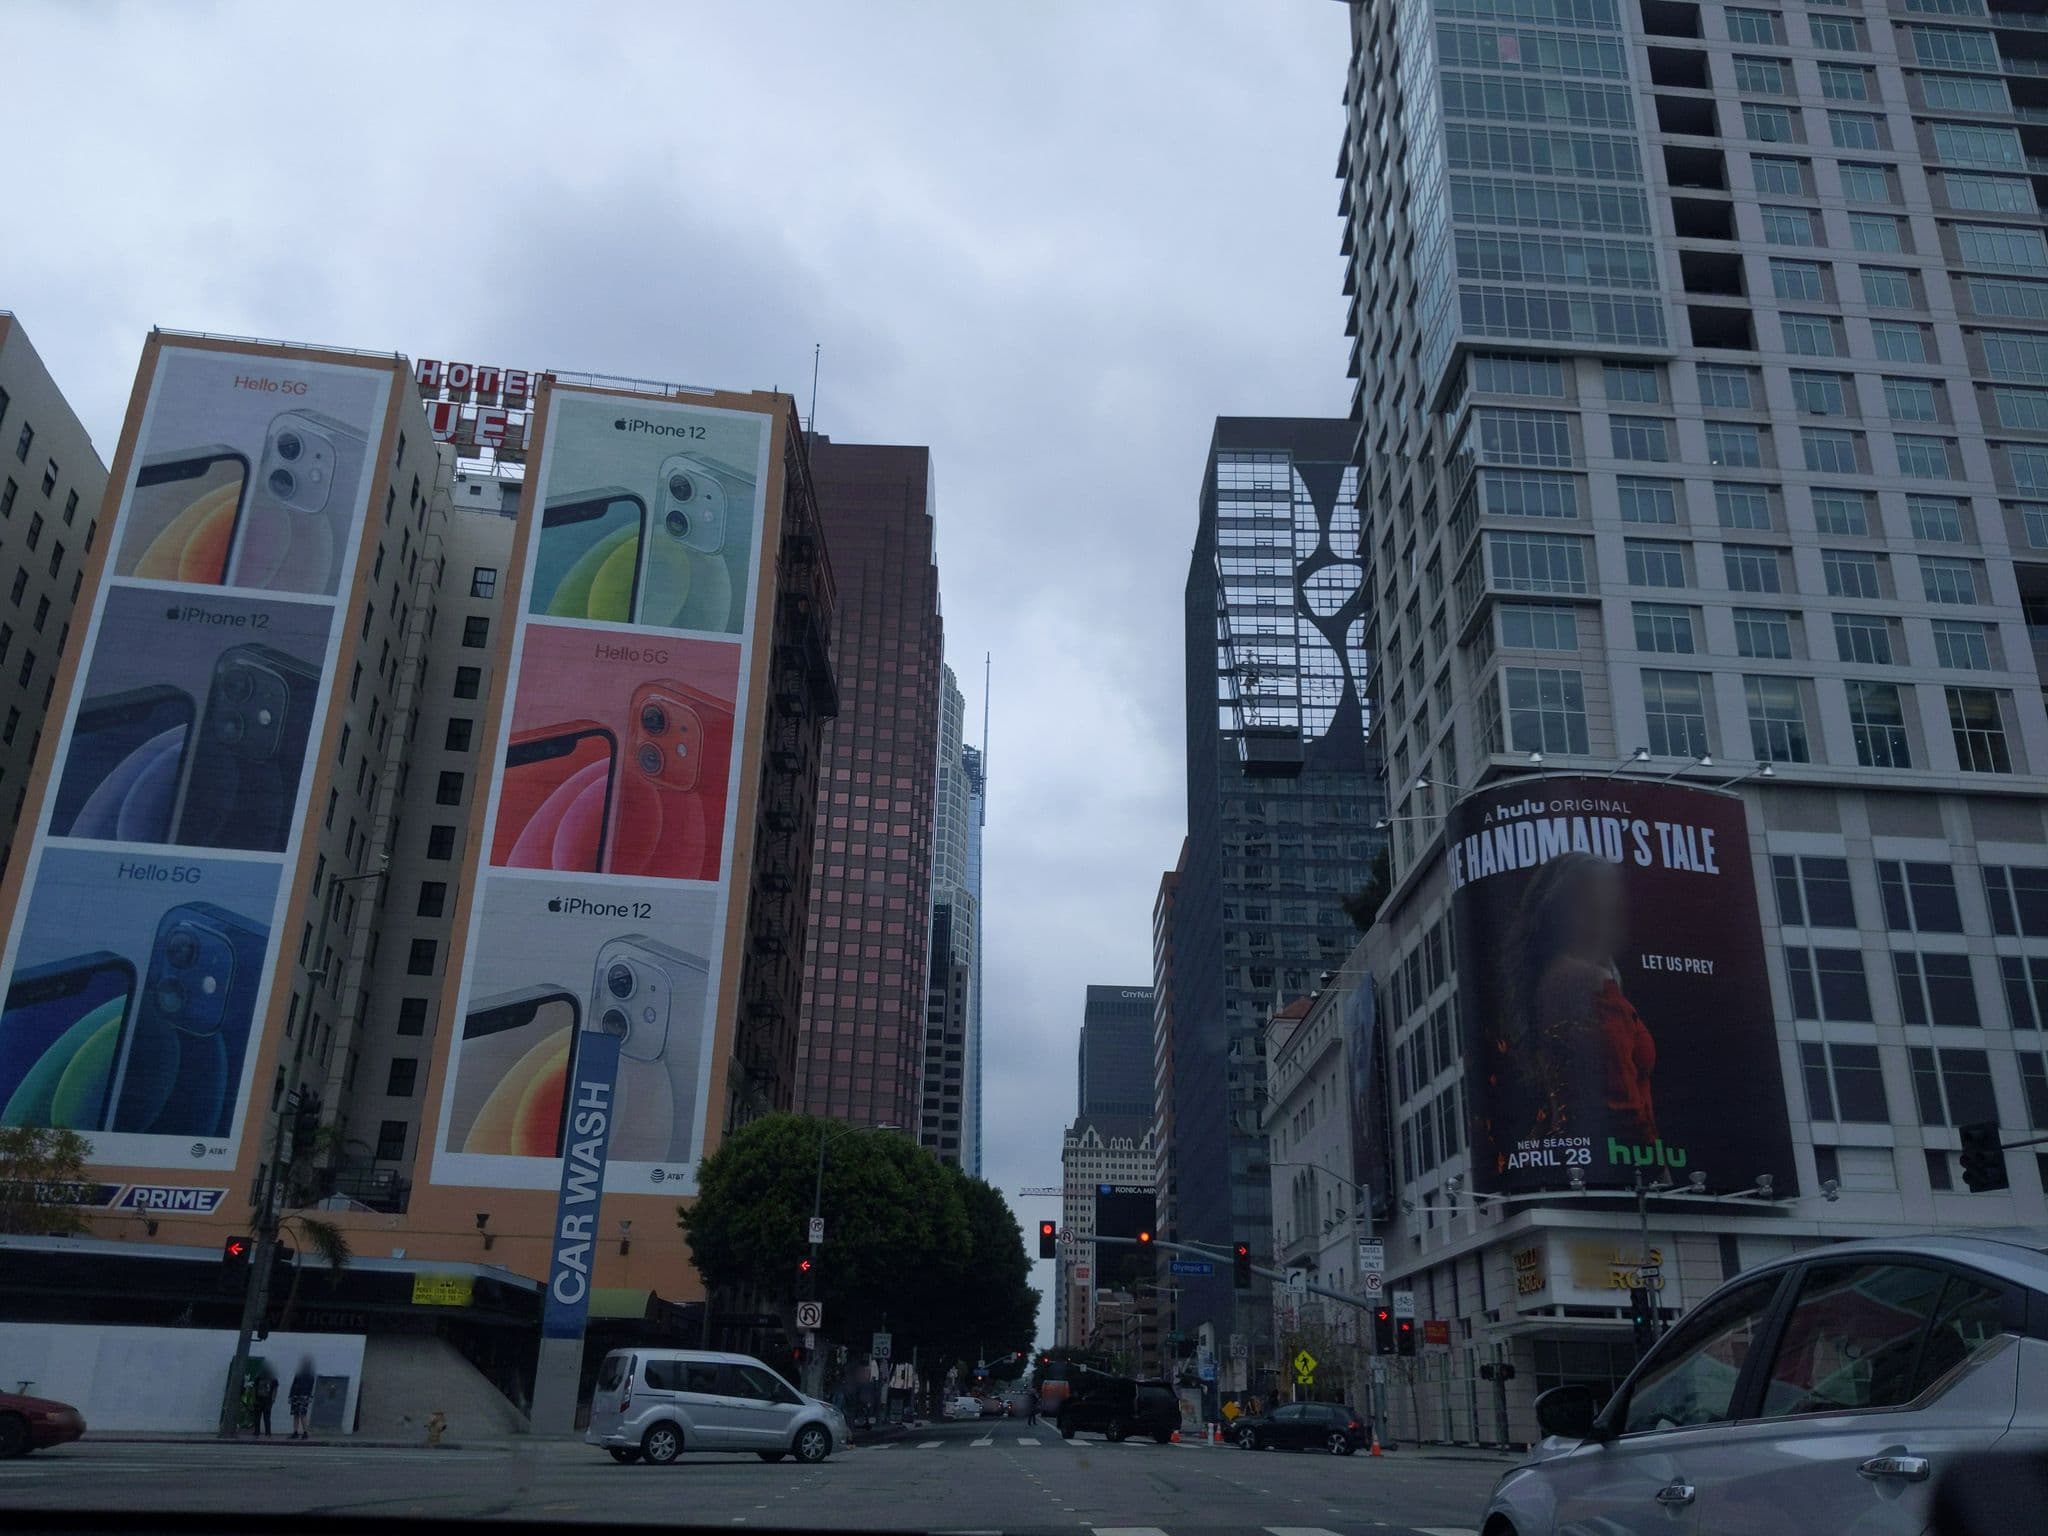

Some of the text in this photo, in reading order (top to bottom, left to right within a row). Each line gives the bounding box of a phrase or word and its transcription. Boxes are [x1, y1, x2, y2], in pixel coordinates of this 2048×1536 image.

[235, 375, 308, 395] Hello 5G
[628, 418, 706, 441] iPhone 12
[182, 607, 270, 629] iPhone 12
[595, 643, 669, 665] Hello 5G
[1483, 798, 1632, 824] A hulu ORIGINAL
[1464, 815, 1653, 882] HANDMAID'S
[1653, 821, 1720, 875] TALE
[118, 863, 201, 884] Hello 5G
[564, 897, 652, 919] iPhone 12
[1641, 953, 1713, 975] LET US PREY
[1517, 1136, 1591, 1150] NEW SEASON
[1607, 1136, 1687, 1168] hulu
[1507, 1148, 1592, 1170] APRIL 28
[666, 1173, 685, 1181] AT&T
[132, 1188, 216, 1210] PRIME
[553, 1081, 611, 1305] CAR WASH
[874, 1346, 889, 1356] 30
